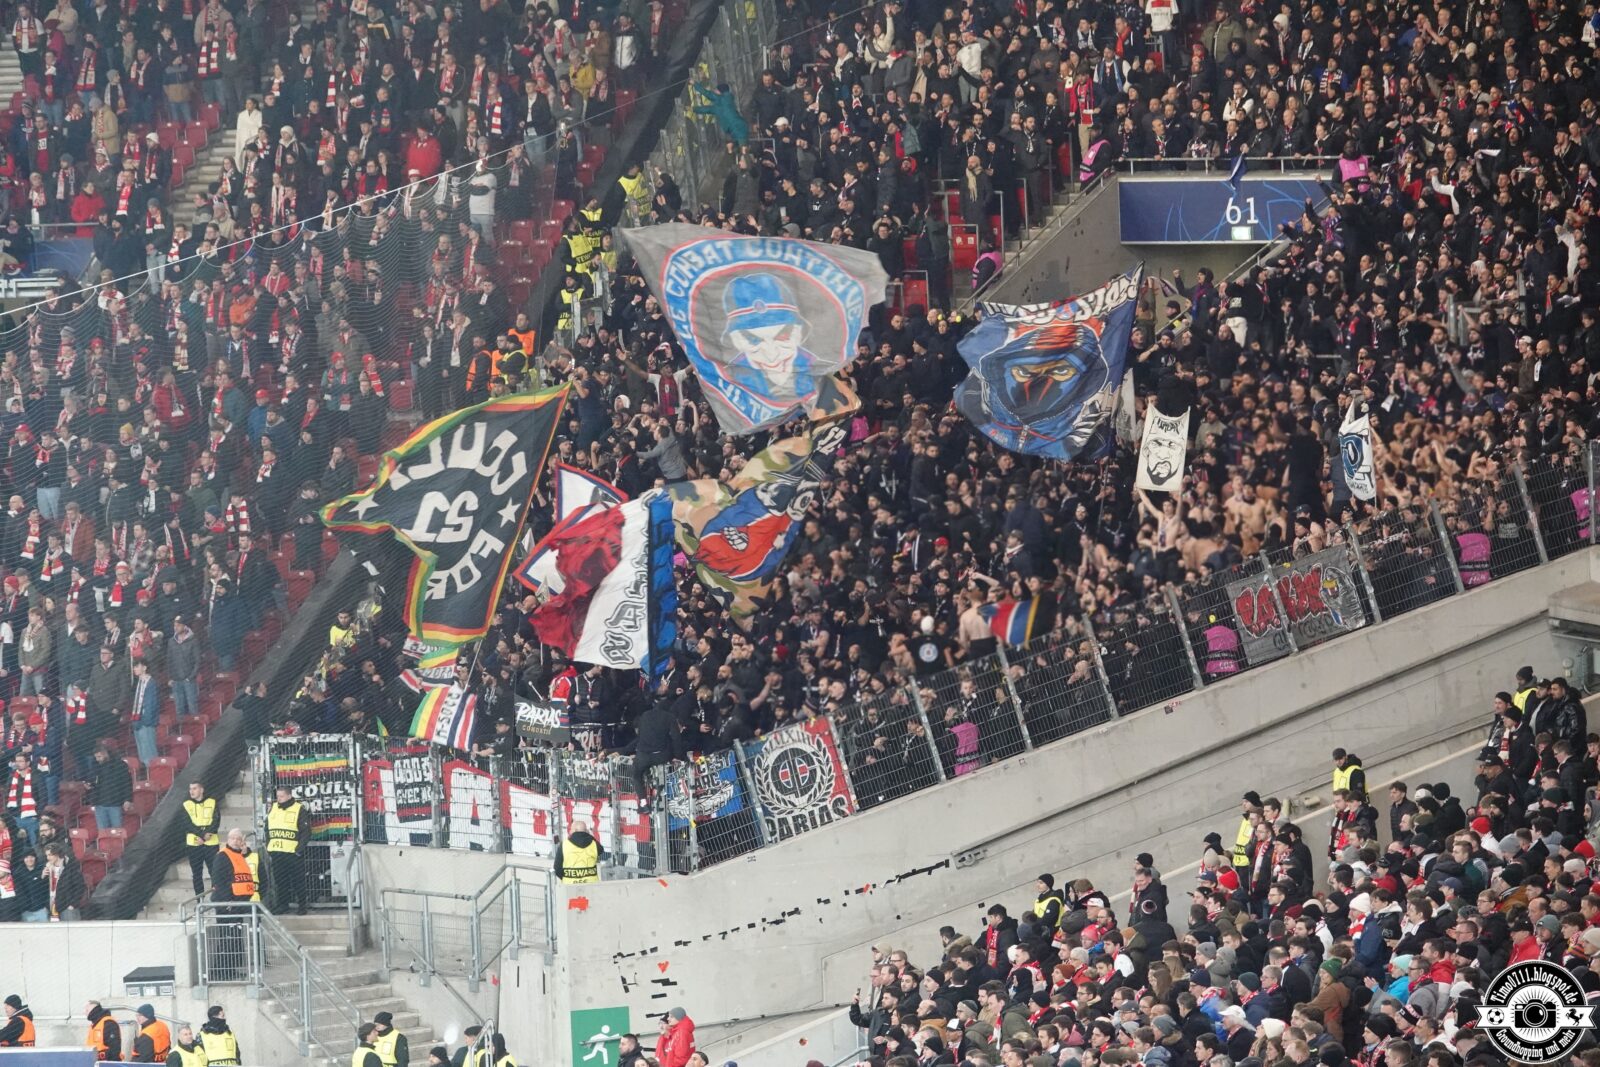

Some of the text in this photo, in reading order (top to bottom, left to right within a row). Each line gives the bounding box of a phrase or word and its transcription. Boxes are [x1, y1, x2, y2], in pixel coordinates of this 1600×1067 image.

[1225, 196, 1259, 225] 61
[665, 240, 736, 299] COMBAT
[745, 239, 864, 324] CONTINUE
[766, 796, 850, 844] PARIAS
